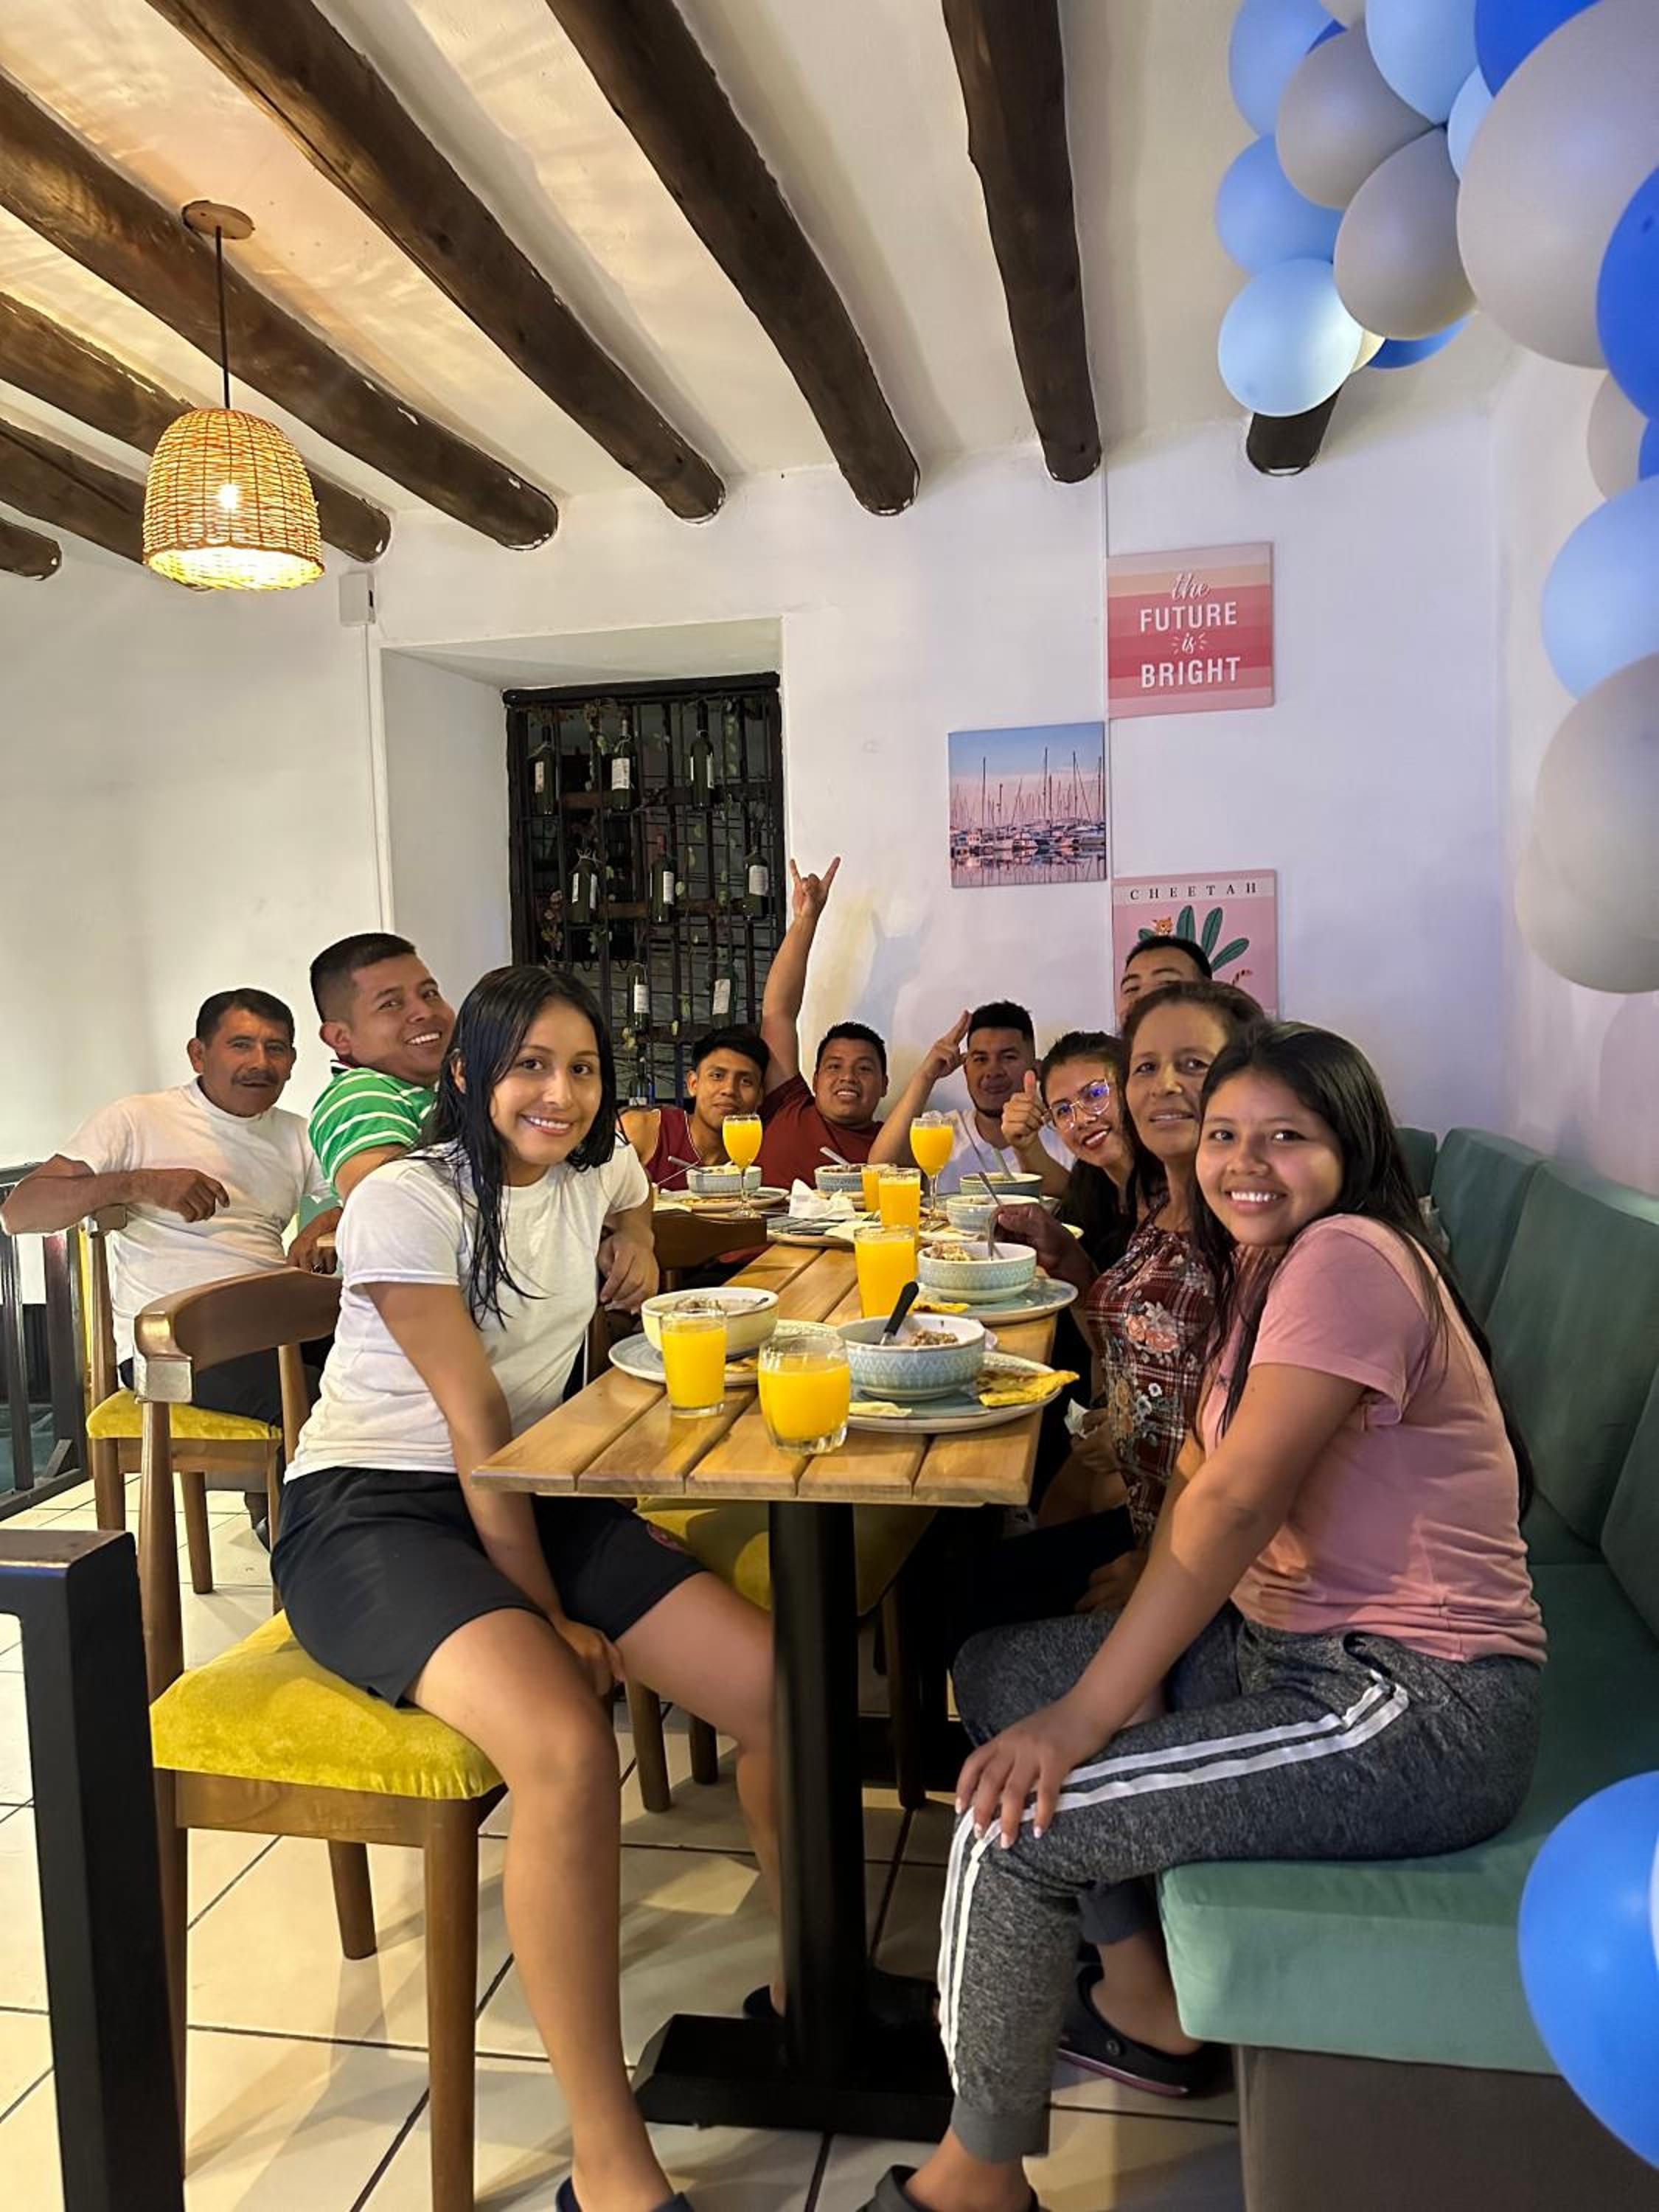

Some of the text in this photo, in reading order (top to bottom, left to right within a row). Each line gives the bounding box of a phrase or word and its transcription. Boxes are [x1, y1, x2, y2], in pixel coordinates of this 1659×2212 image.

[1171, 573, 1211, 599] the
[1141, 602, 1237, 632] FUTURE
[1182, 633, 1195, 653] is
[1141, 657, 1240, 688] BRIGHT
[1130, 883, 1256, 900] CHEETAH
